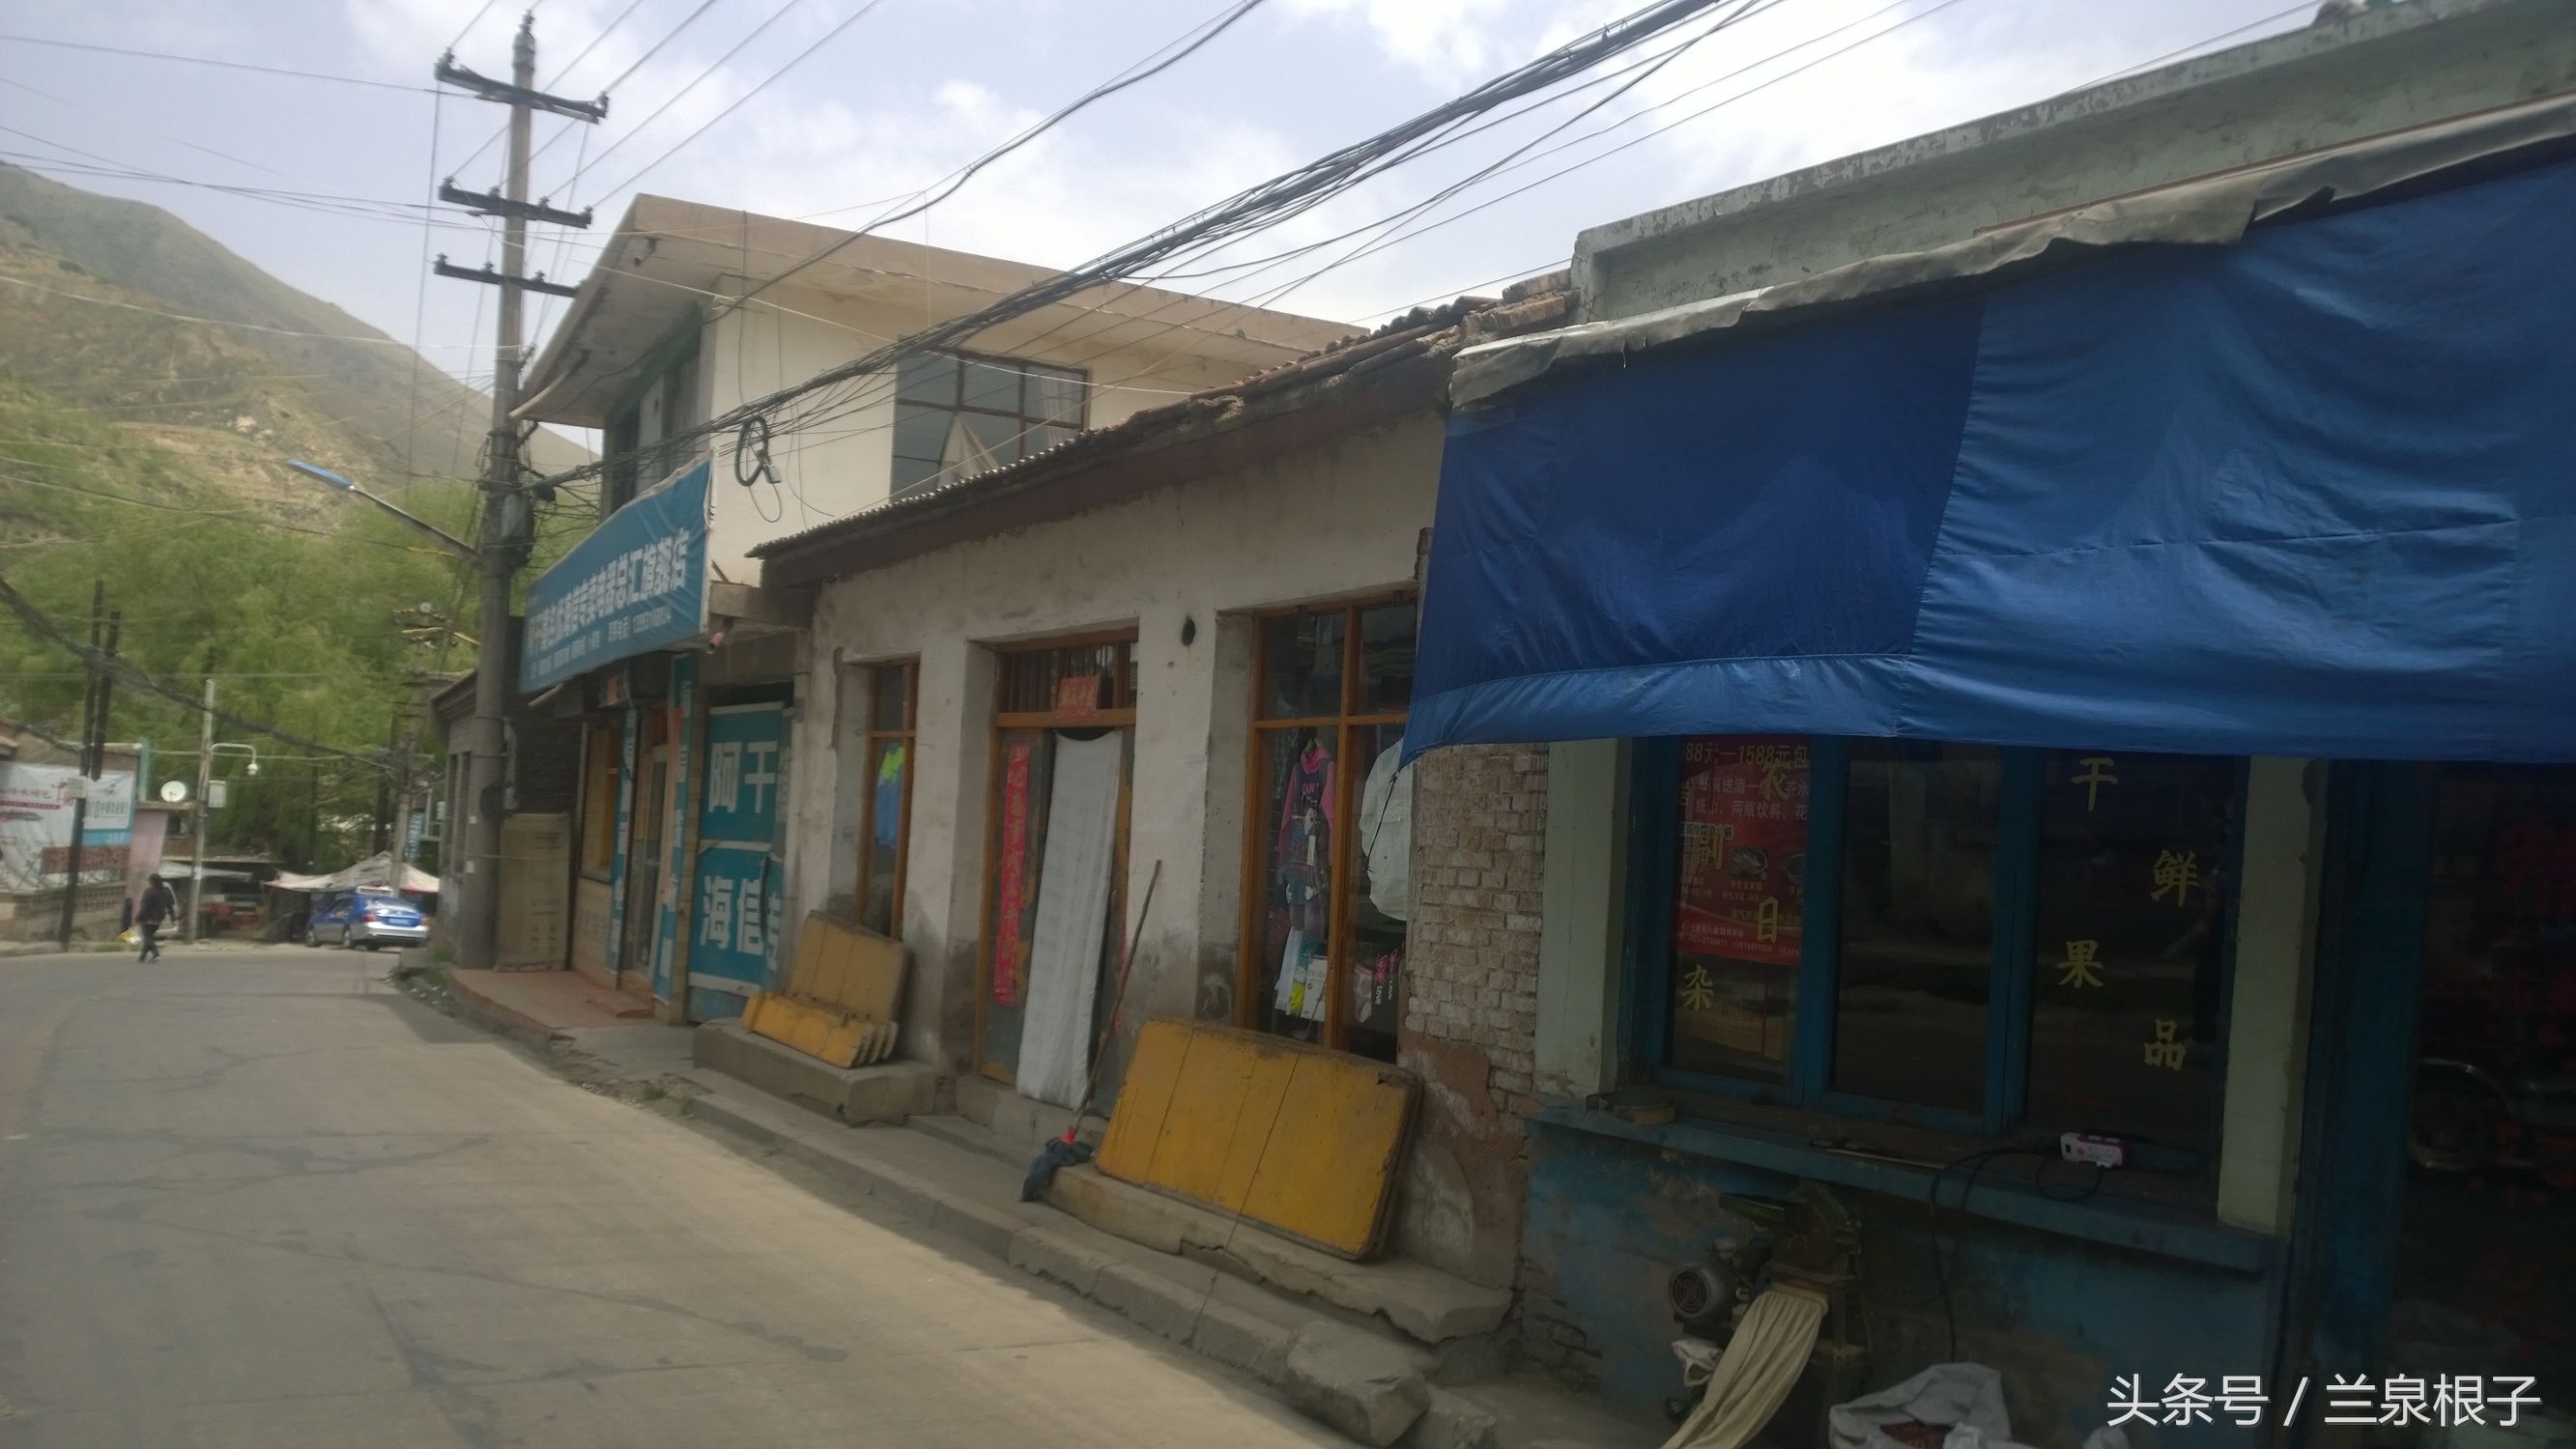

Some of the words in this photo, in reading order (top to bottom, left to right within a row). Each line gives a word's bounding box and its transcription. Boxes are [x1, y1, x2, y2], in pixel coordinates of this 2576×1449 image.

[2071, 757, 2117, 811] 干
[2151, 850, 2199, 907] 鲜
[1757, 895, 1779, 944] 日
[1681, 964, 1714, 1010] 杂
[2057, 940, 2104, 988] 果
[2144, 1018, 2187, 1070] 品
